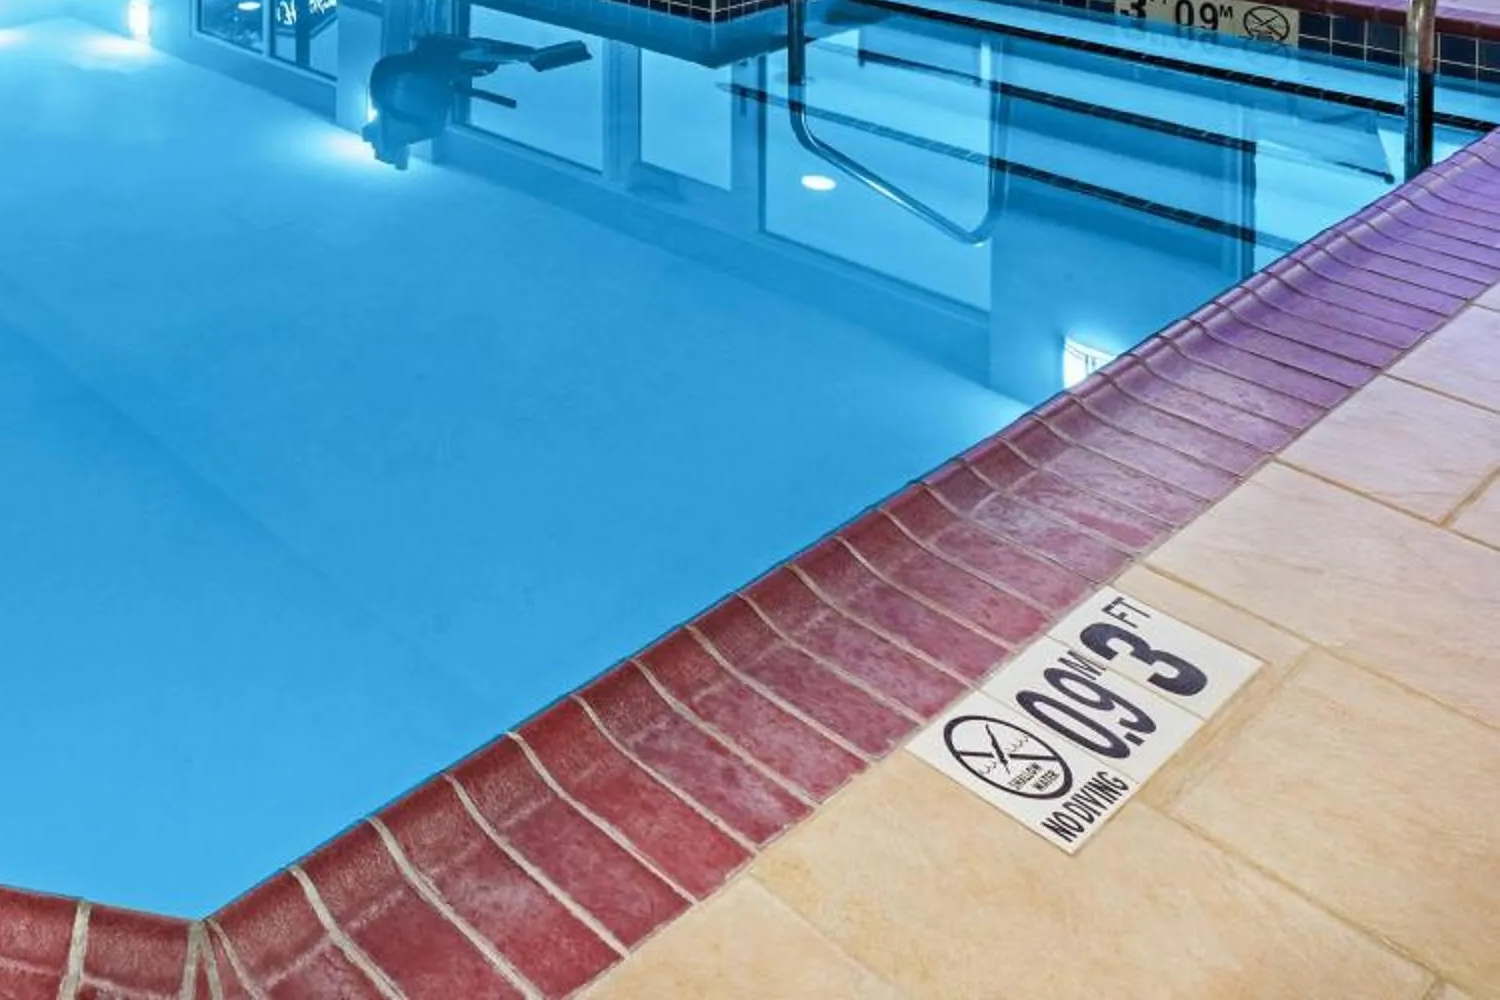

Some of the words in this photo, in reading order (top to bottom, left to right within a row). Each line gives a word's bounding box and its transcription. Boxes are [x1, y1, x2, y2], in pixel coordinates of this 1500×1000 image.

[1219, 4, 1234, 19] M
[1102, 597, 1151, 628] FT
[1079, 622, 1208, 697] 3
[1041, 811, 1085, 842] NO
[1071, 771, 1129, 824] DIVING
